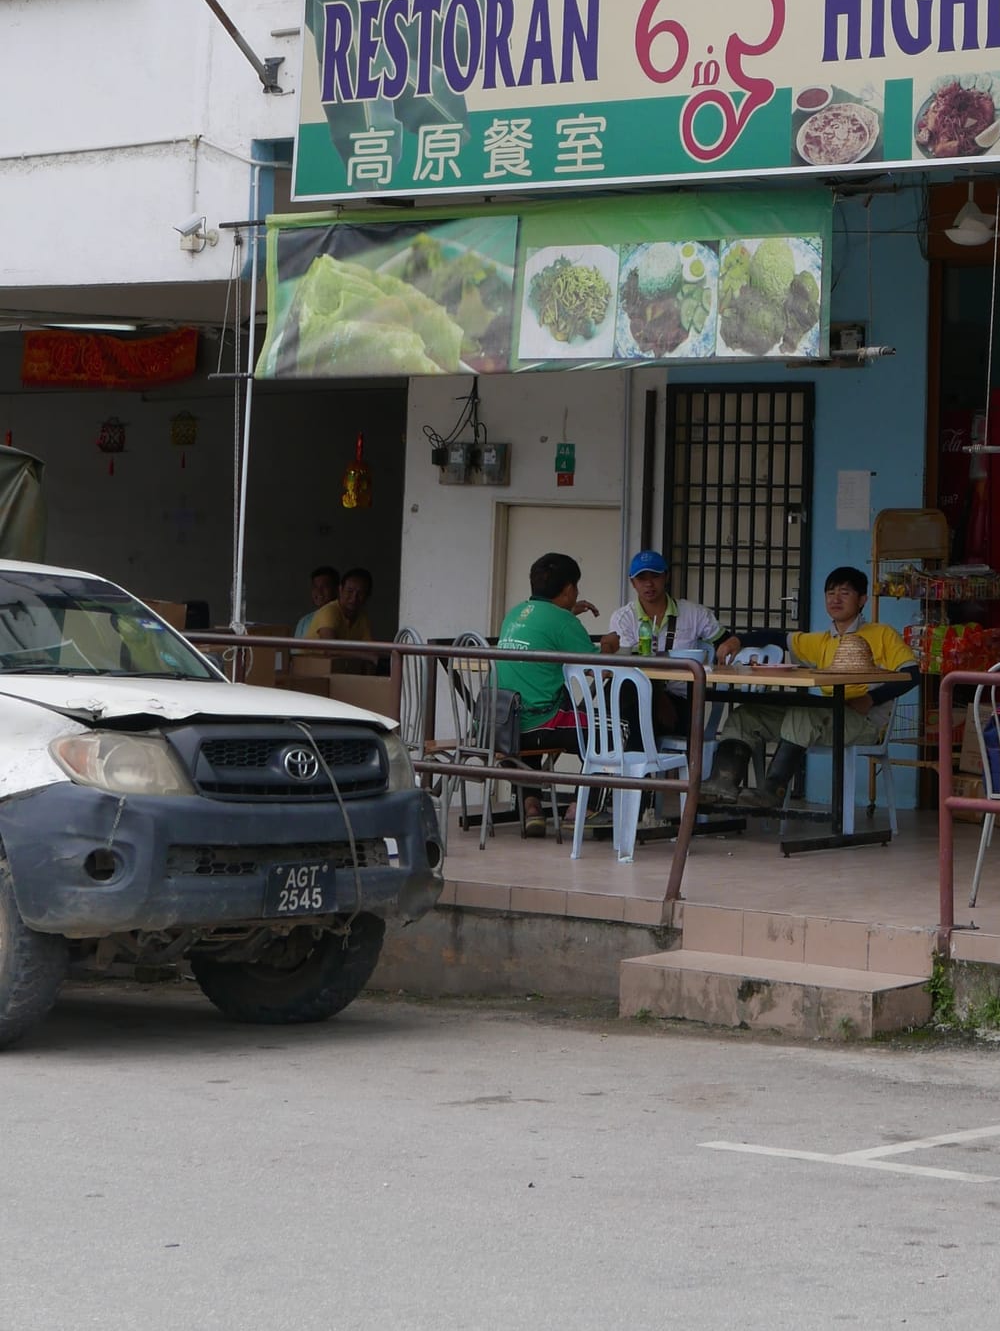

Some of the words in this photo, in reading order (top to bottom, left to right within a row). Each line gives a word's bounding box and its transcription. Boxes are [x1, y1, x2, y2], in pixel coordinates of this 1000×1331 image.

[346, 113, 607, 187] 高原餐室
[284, 865, 320, 889] AGT
[277, 887, 323, 912] 2545
